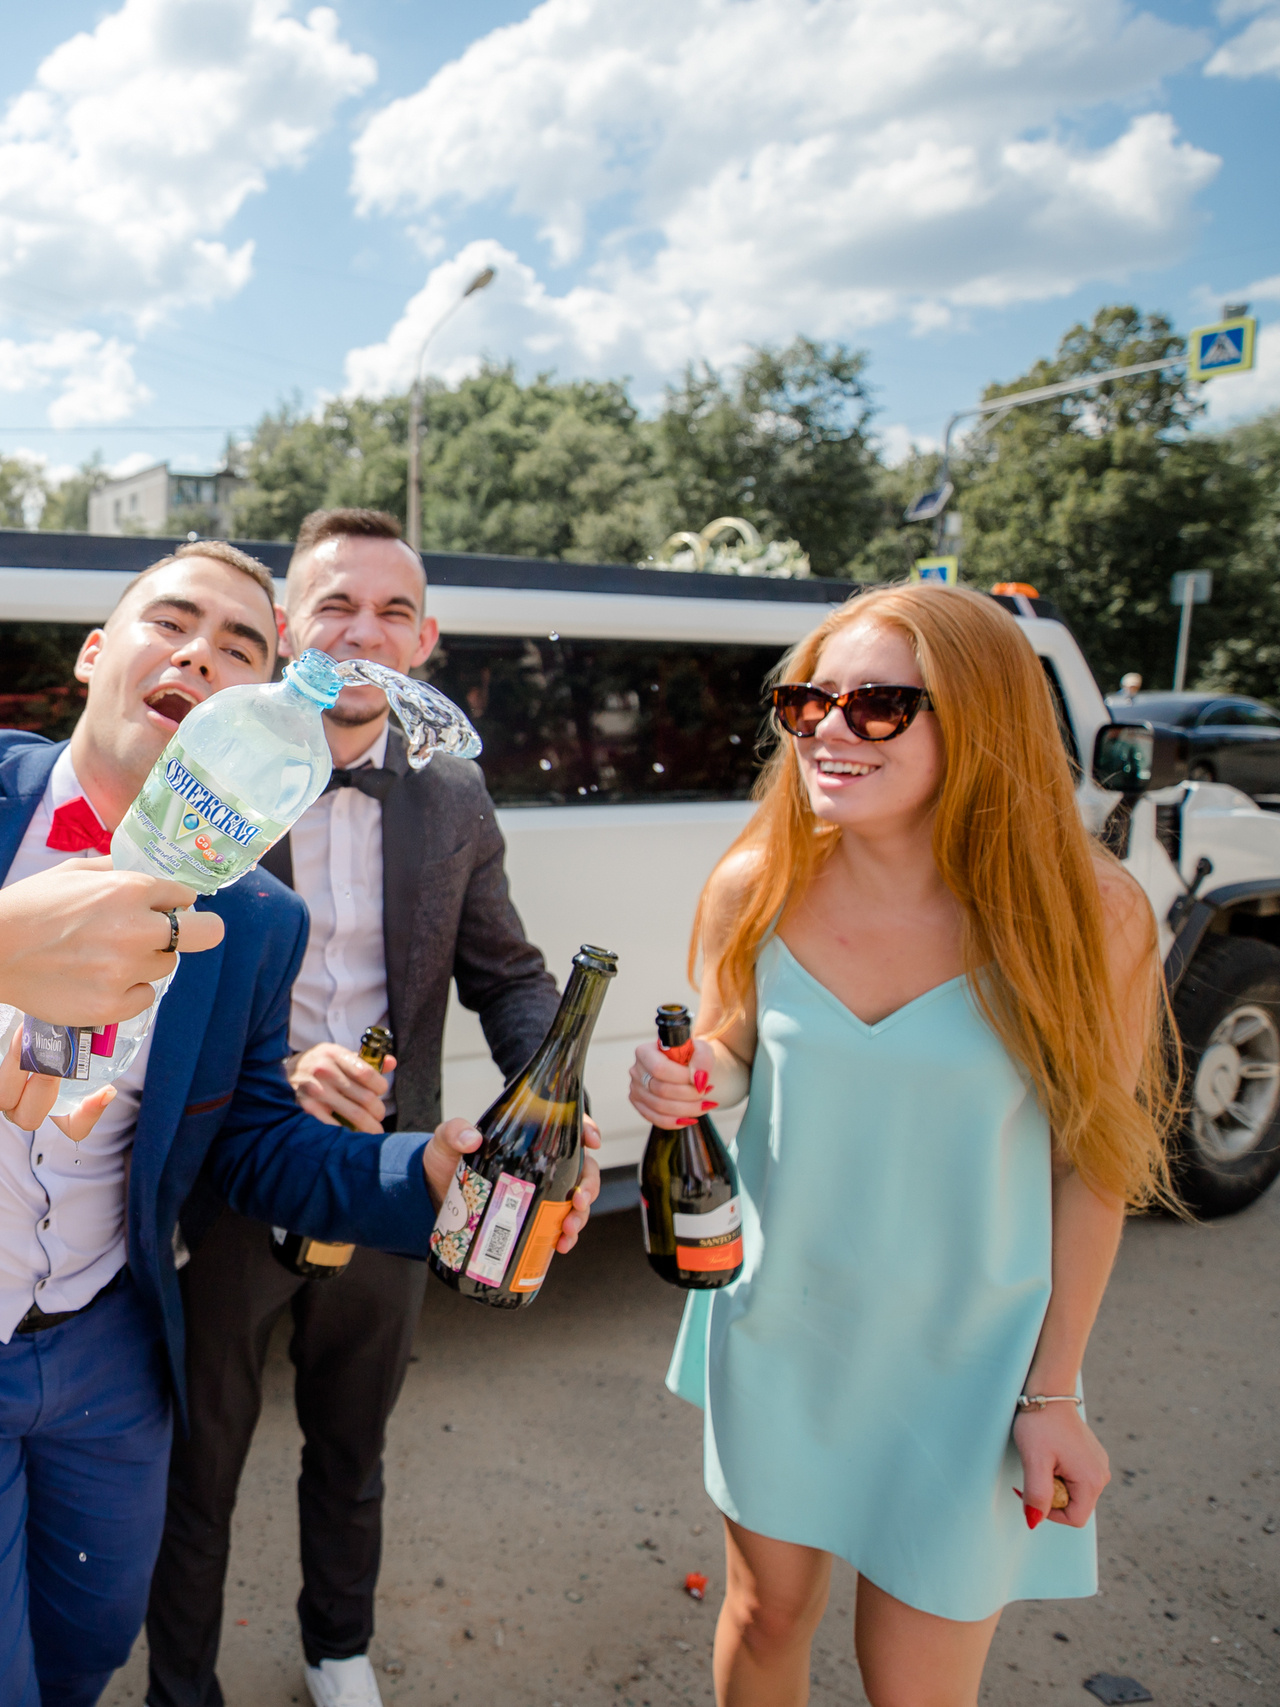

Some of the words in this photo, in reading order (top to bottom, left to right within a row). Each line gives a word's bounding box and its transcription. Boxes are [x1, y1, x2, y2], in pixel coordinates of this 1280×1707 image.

[166, 758, 261, 846] СЕНЕЖСКАЯ
[196, 836, 209, 849] Ca
[148, 840, 181, 868] питьевая
[204, 849, 215, 860] Mg
[35, 1031, 62, 1052] Winston
